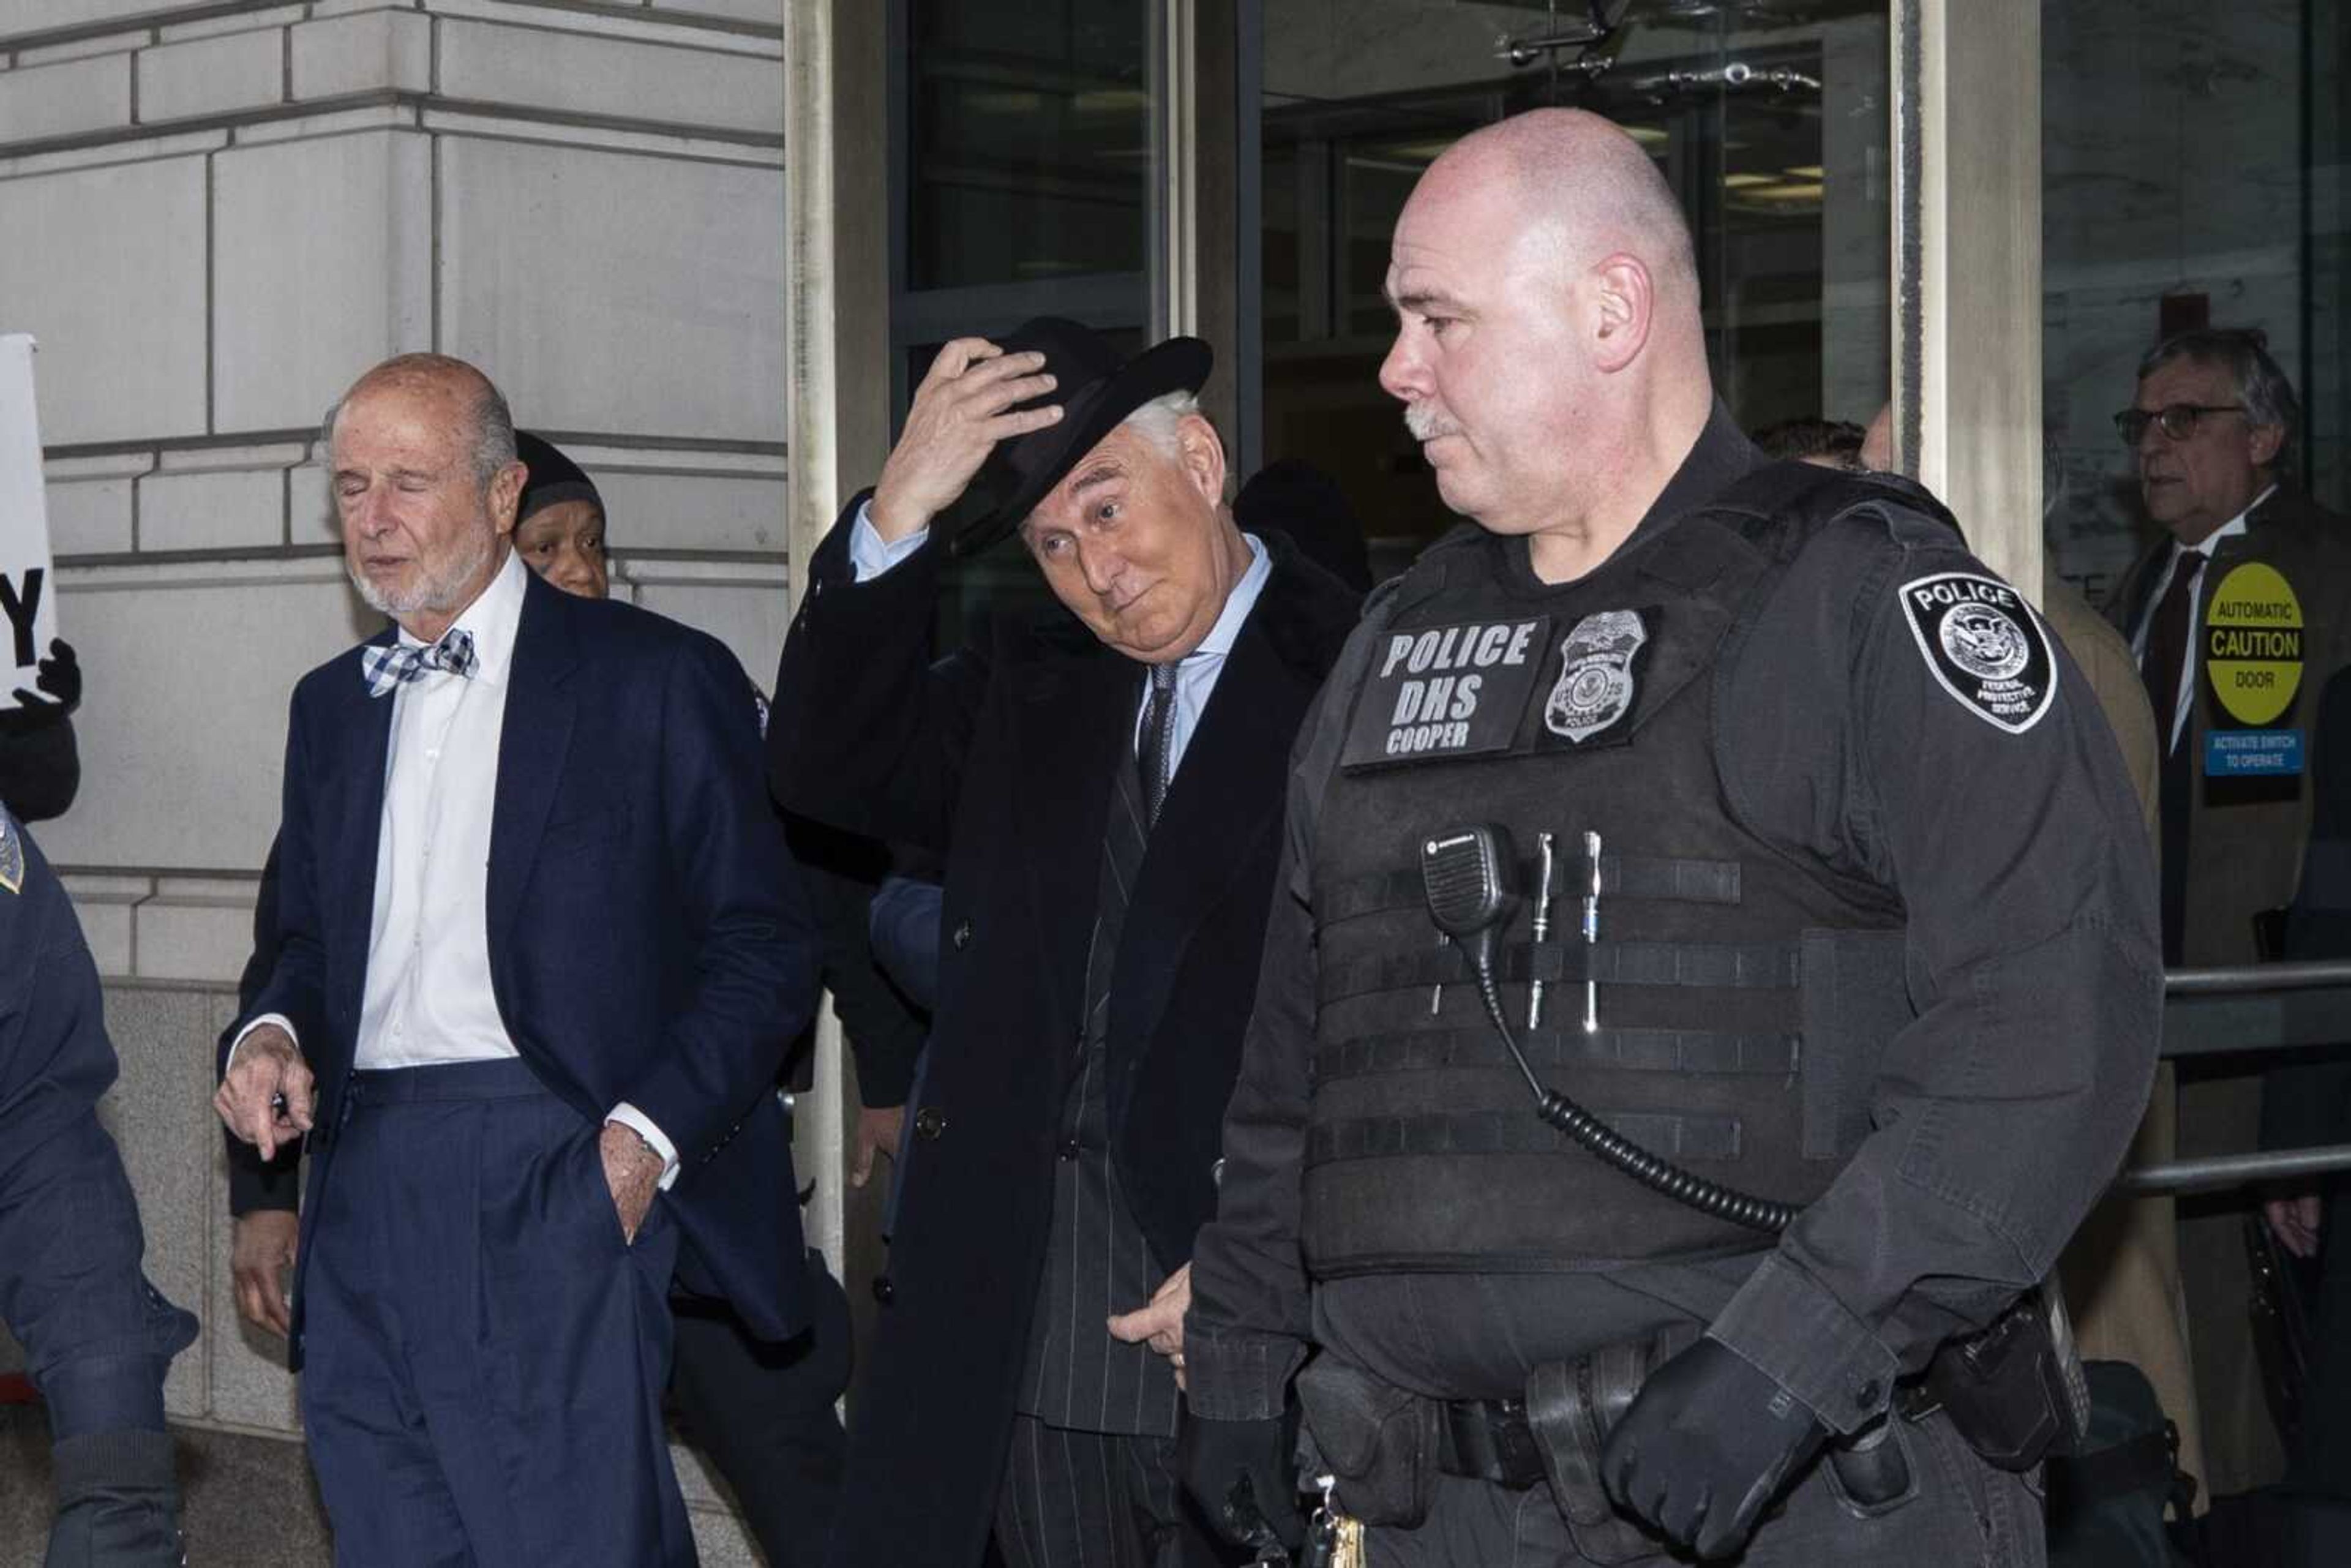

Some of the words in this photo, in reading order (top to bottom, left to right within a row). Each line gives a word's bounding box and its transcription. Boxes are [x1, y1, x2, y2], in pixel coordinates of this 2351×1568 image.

[1914, 582, 2015, 610] POLICE
[2218, 601, 2292, 620] AUTOMATIC
[1380, 623, 1537, 678] POLICE
[2211, 630, 2299, 657] CAUTION
[2236, 671, 2274, 688] DOOR
[1392, 675, 1482, 726] DHS
[1386, 722, 1469, 754] COOPER
[2214, 736, 2258, 749] ACTIVATE
[2262, 735, 2295, 748] SWITCH
[2227, 754, 2238, 767] TO
[2241, 754, 2284, 767] OPERATE
